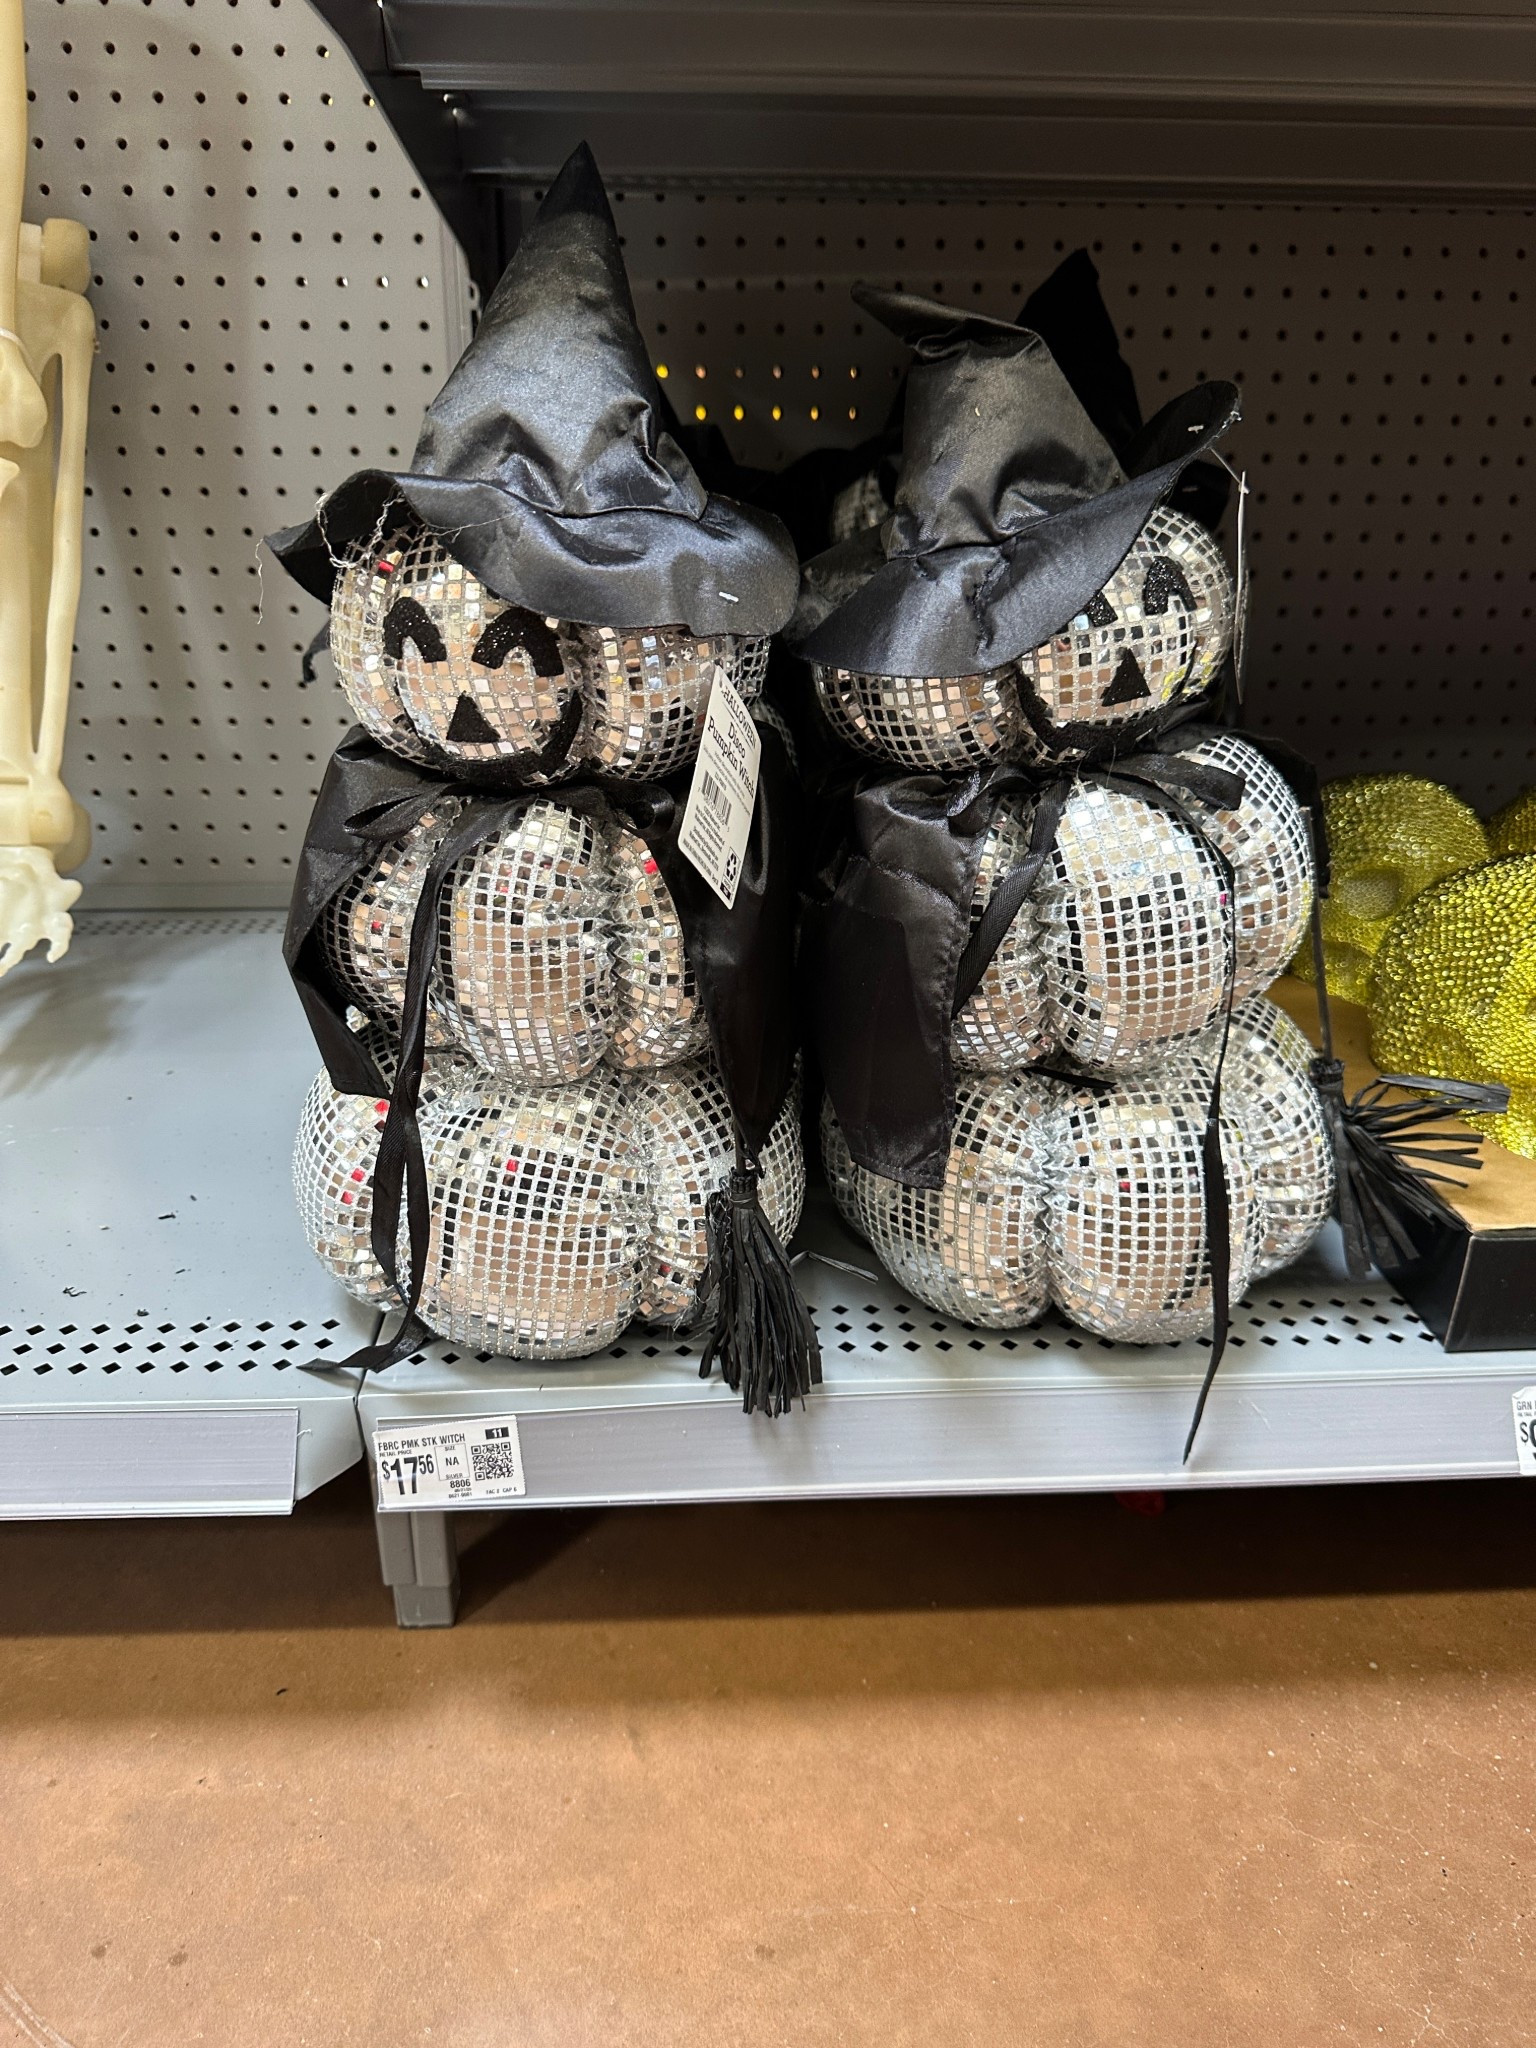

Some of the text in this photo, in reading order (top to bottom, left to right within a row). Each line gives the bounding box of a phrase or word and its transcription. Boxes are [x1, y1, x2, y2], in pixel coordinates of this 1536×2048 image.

[722, 686, 757, 749] HALLOWEEN
[728, 721, 746, 759] Disco
[708, 715, 738, 771] Pumpkin
[738, 760, 755, 799] Witch
[1516, 1400, 1532, 1411] GRN
[491, 1428, 503, 1438] 11
[378, 1433, 465, 1451] FBRC PMK STK WITCH
[445, 1457, 459, 1466] NA
[449, 1478, 471, 1489] 8806
